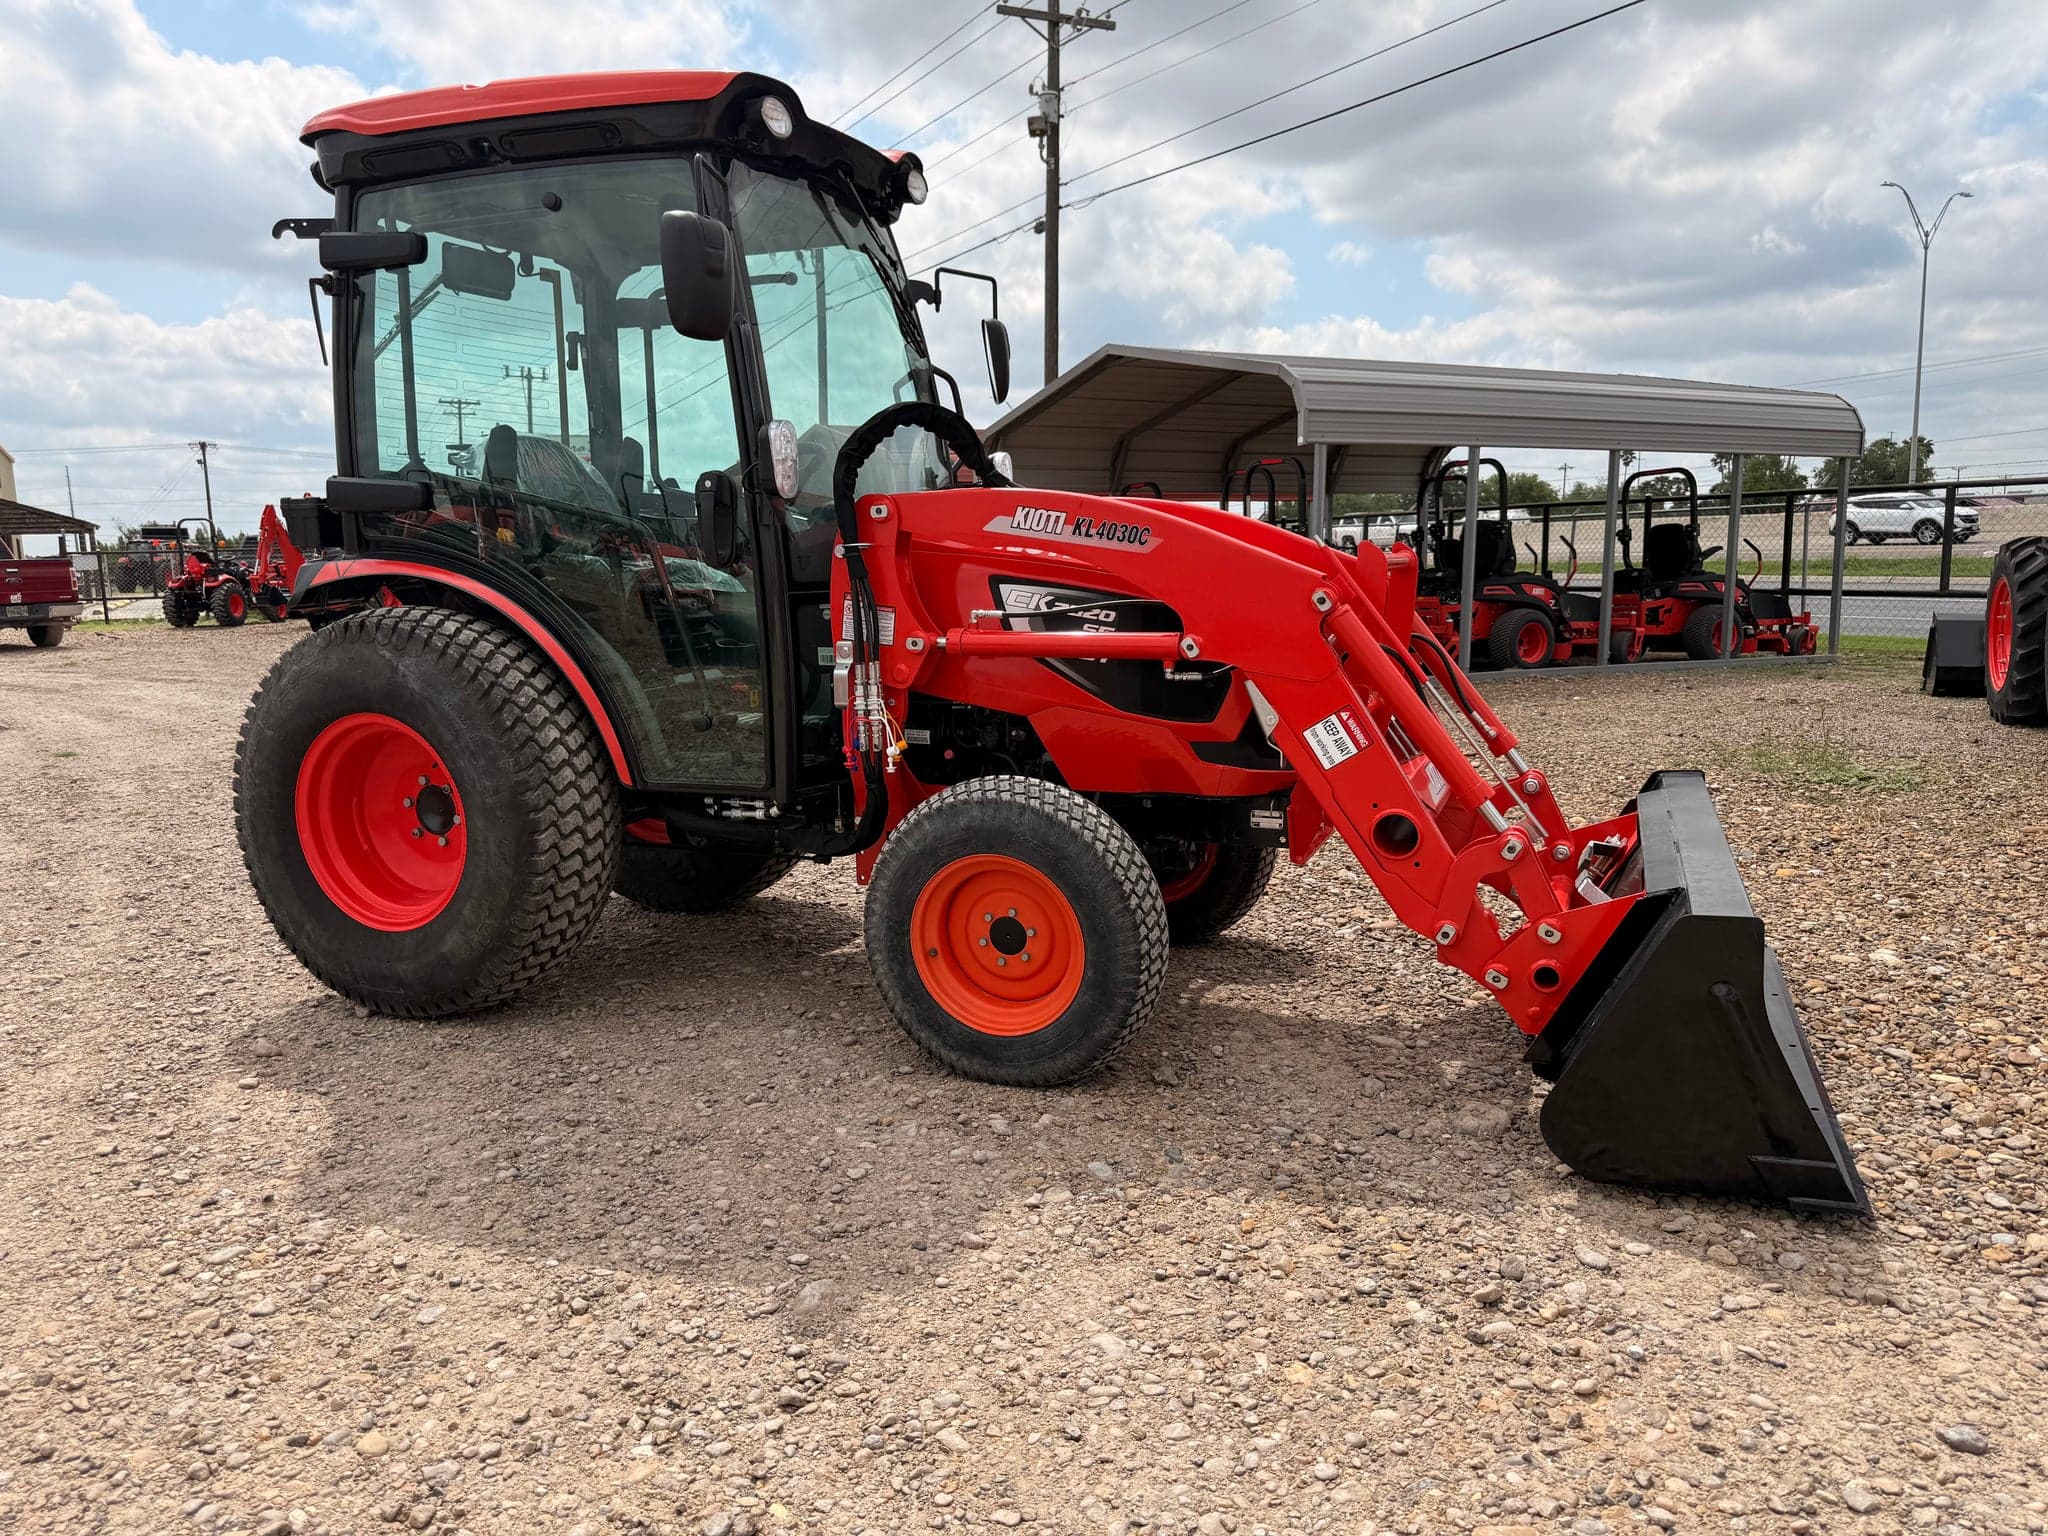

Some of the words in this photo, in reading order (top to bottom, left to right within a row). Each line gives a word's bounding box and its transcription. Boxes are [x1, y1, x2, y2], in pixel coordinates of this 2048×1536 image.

[1011, 506, 1067, 535] KIOTI
[1072, 517, 1150, 546] KL4030C
[1321, 718, 1340, 737] KEEP
[1332, 736, 1353, 757] AWAY
[1346, 718, 1368, 748] WARNING
[1316, 738, 1330, 757] working
[1326, 754, 1336, 766] area
